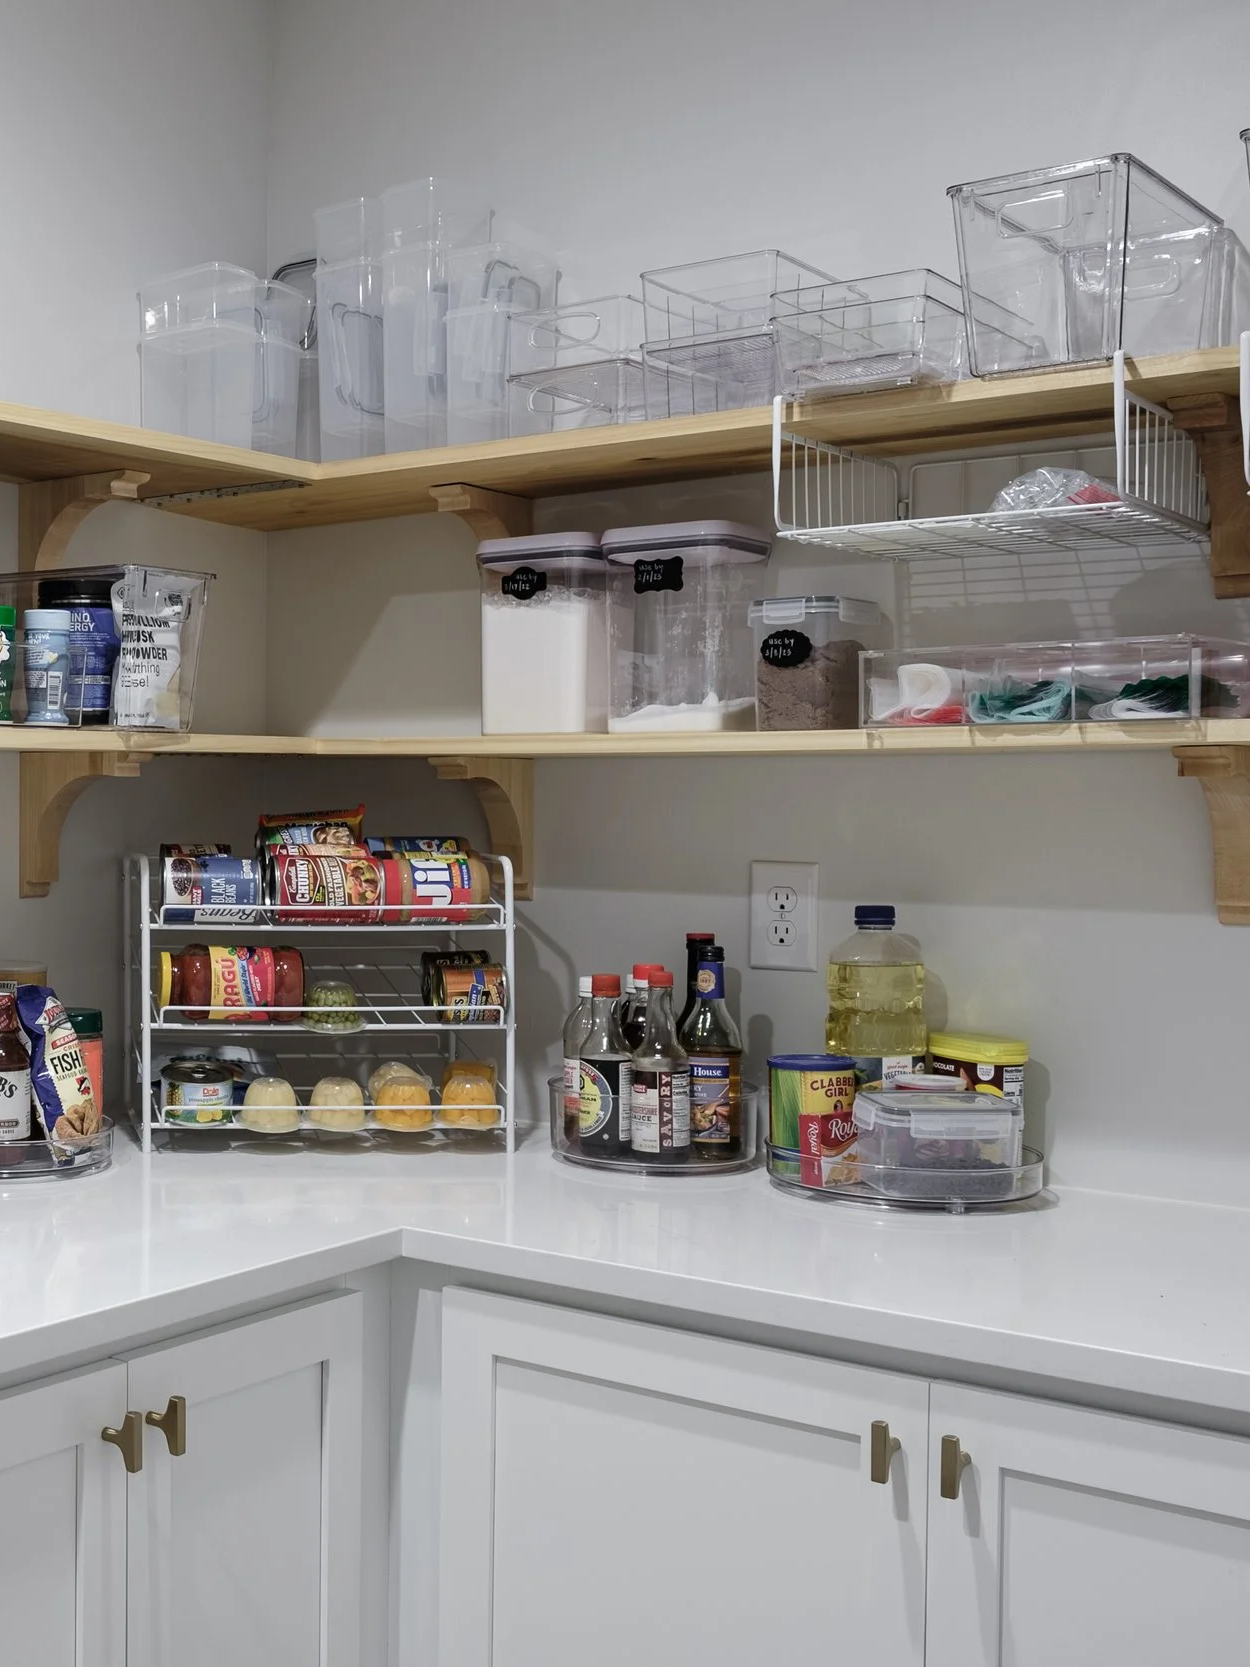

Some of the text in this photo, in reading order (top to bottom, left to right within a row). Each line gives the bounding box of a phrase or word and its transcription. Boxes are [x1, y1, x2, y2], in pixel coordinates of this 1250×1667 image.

[784, 637, 795, 647] by
[211, 877, 226, 903] BLACK
[295, 859, 310, 902] CHUNKY
[331, 867, 344, 907] VEGETABLE
[410, 858, 452, 905] Jif
[225, 884, 237, 904] BEANS
[201, 908, 258, 920] Beans
[50, 1050, 82, 1075] FISH
[693, 1066, 722, 1077] House
[203, 1087, 220, 1096] Dole
[825, 1087, 849, 1098] GIRL
[807, 1121, 821, 1155] Royal
